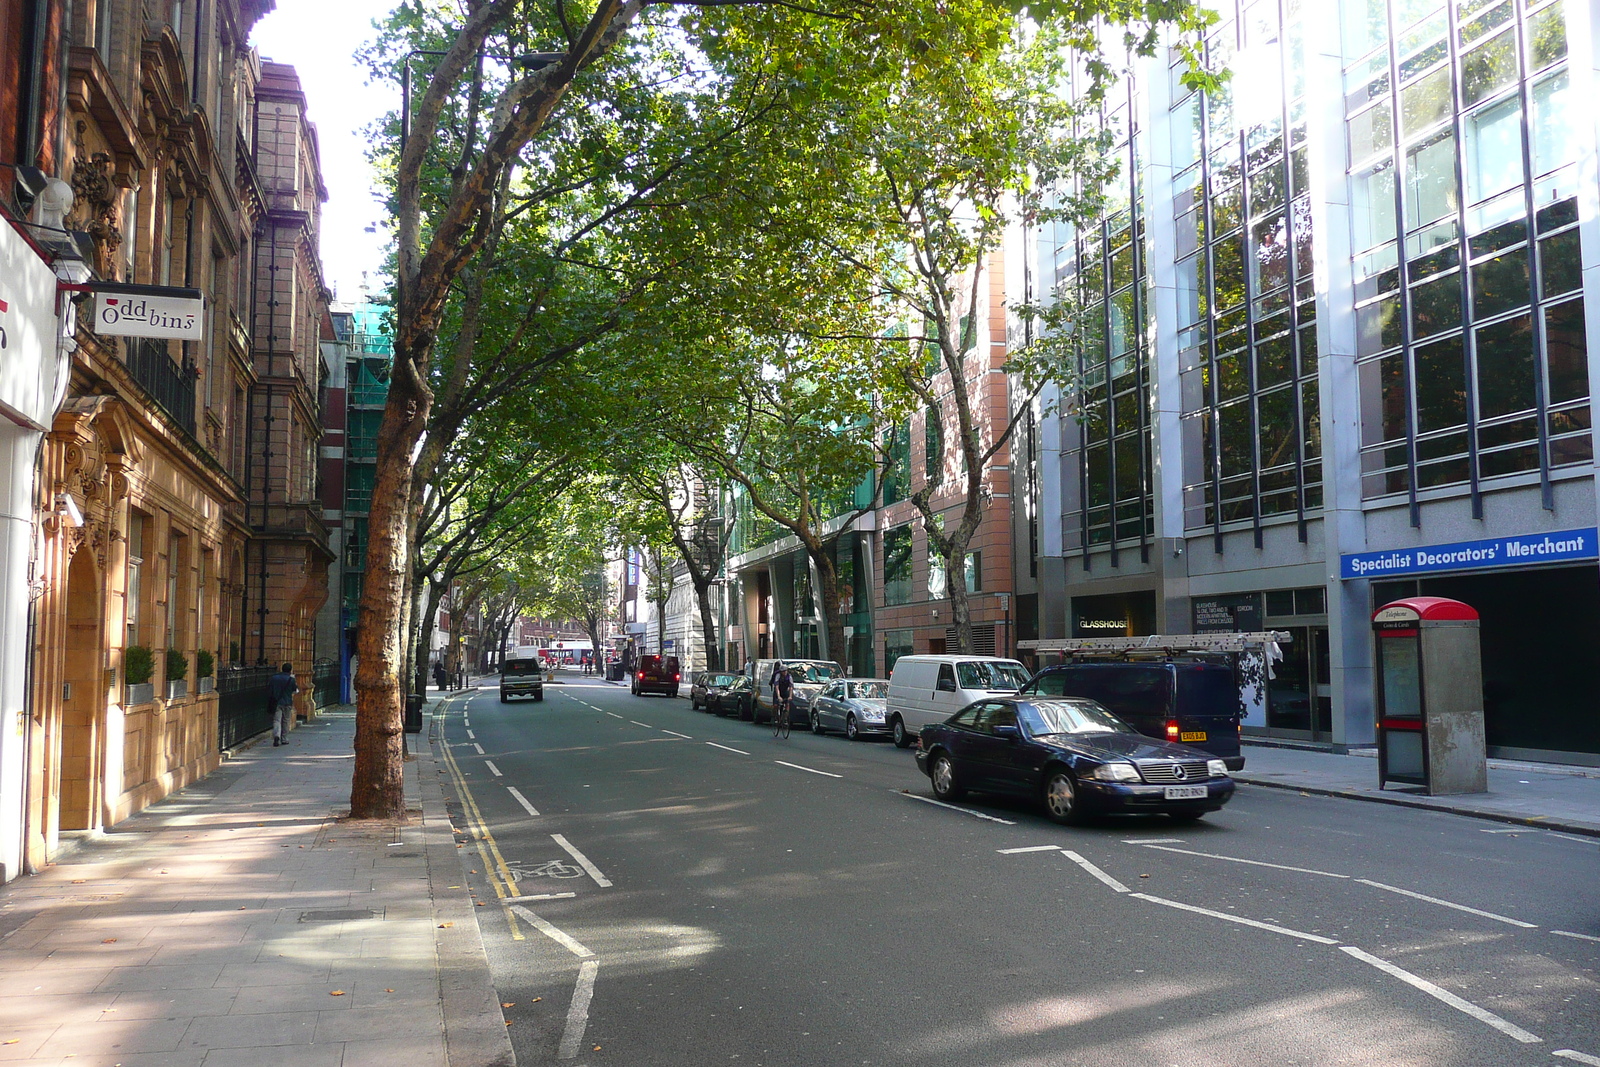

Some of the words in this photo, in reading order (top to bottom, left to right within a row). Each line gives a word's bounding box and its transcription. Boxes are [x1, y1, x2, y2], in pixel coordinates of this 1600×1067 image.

[1351, 553, 1411, 575] Specialist
[1416, 543, 1500, 566] Decorators'
[1506, 536, 1584, 557] Merchant
[1386, 610, 1407, 618] Telephone
[1079, 620, 1128, 629] GLASSHOUSE
